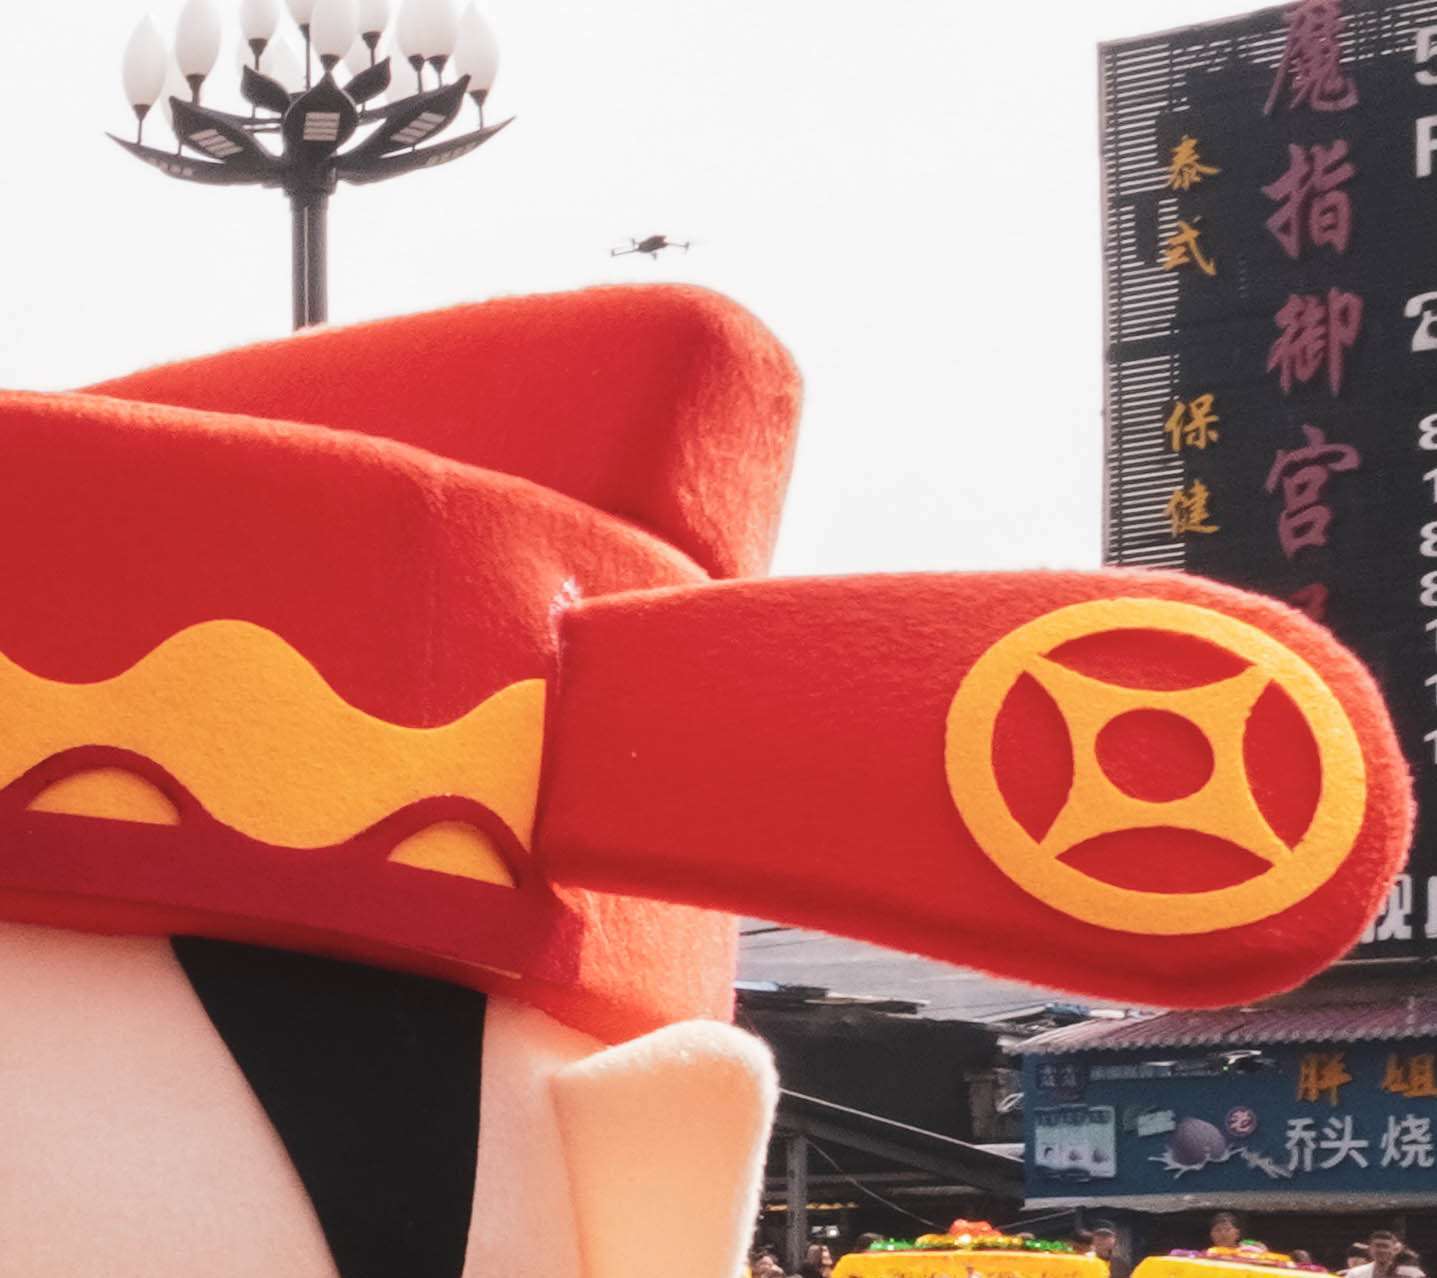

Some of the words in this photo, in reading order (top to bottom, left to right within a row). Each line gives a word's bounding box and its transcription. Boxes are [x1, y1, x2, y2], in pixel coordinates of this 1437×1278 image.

[1162, 134, 1220, 538] 泰式保健
[1261, 0, 1364, 622] 魔指御宫
